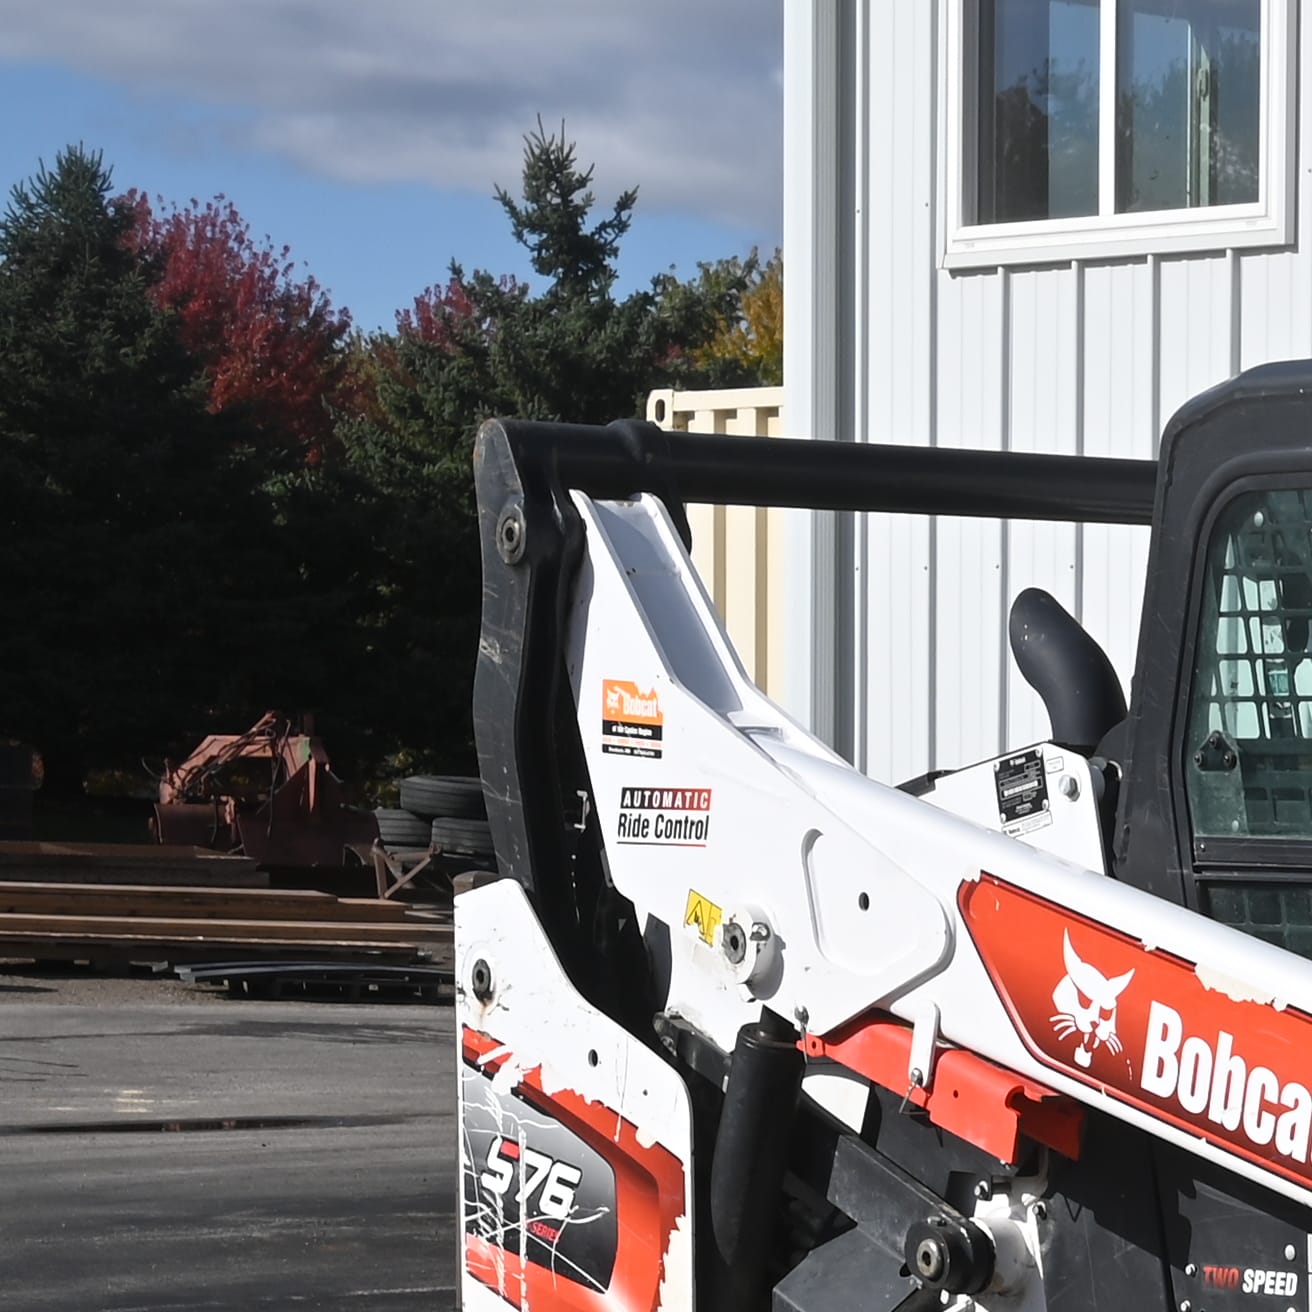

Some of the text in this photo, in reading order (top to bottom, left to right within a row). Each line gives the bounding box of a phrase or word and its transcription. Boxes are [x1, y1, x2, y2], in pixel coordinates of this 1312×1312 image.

[622, 790, 709, 809] AUTOMATIC
[617, 813, 710, 841] Ride Control
[1203, 1266, 1298, 1297] TWO SPEED
